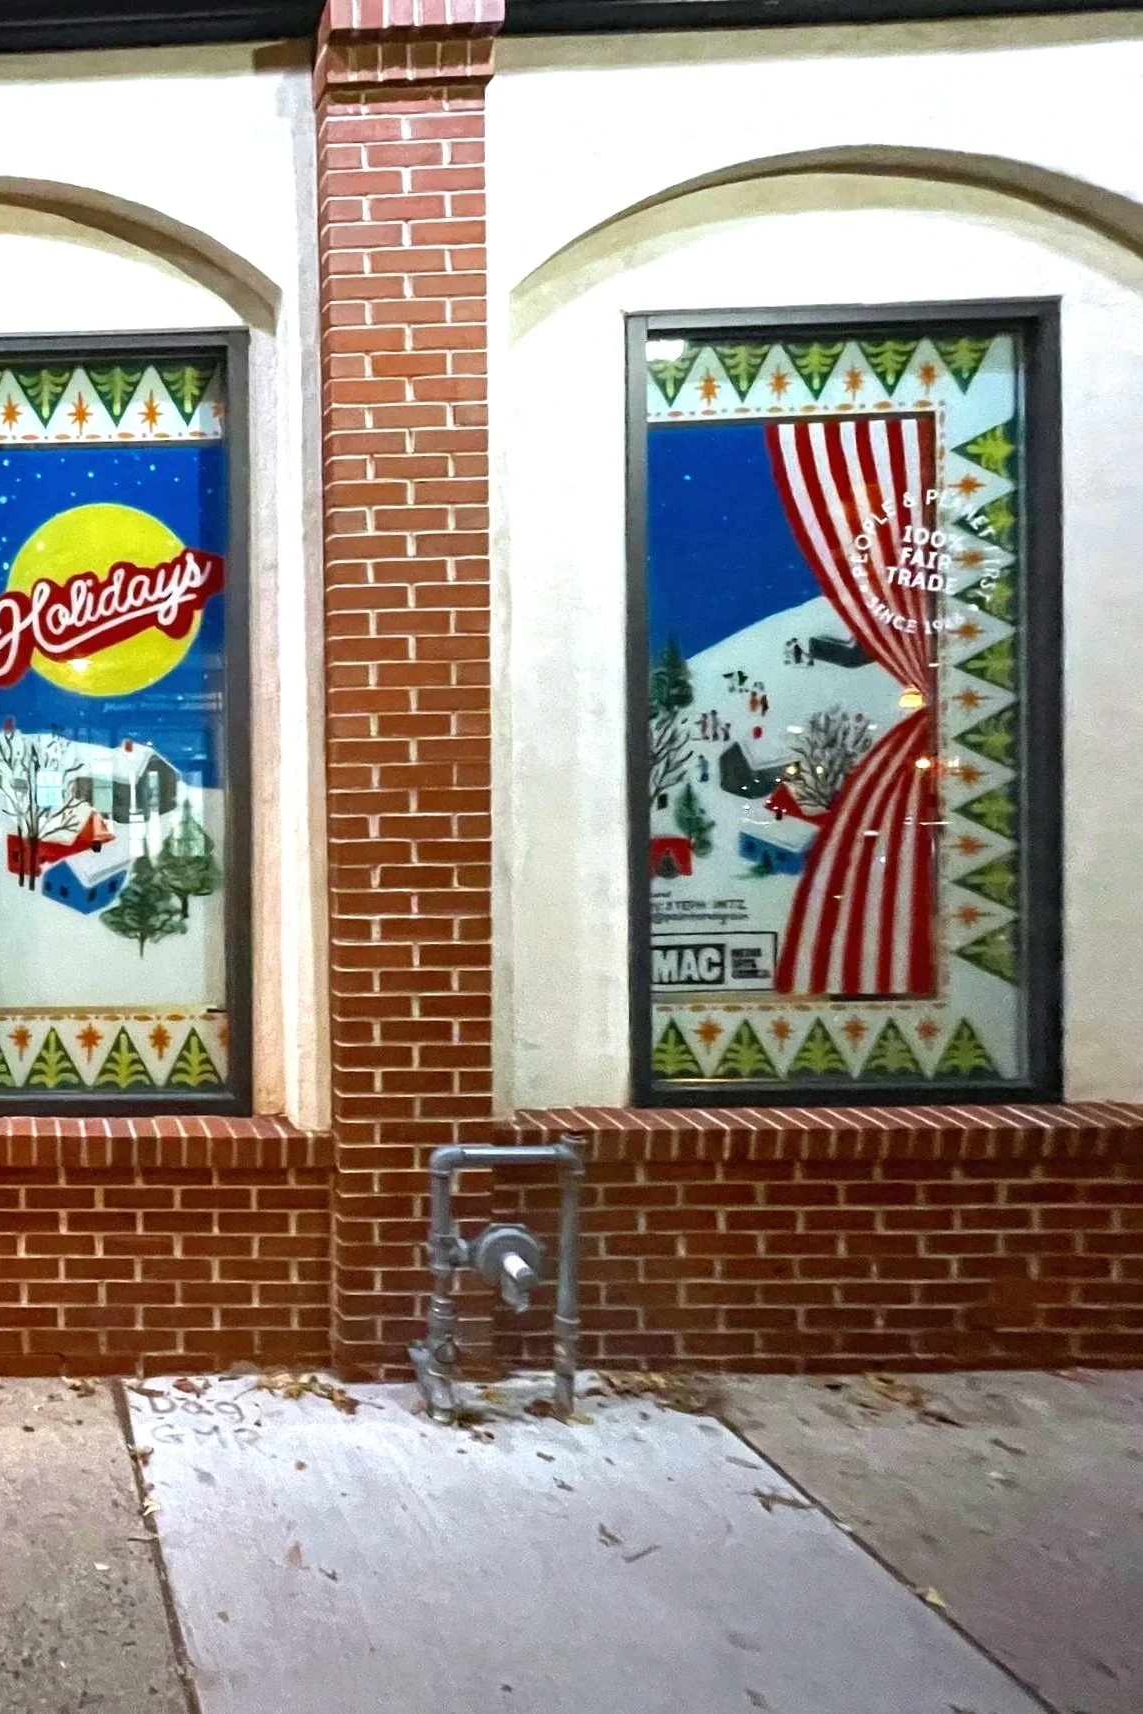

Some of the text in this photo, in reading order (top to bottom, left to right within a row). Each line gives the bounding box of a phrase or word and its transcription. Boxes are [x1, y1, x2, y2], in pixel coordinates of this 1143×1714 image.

[898, 546, 953, 572] FAIR
[886, 565, 958, 597] TRADE
[651, 946, 723, 983] MAC
